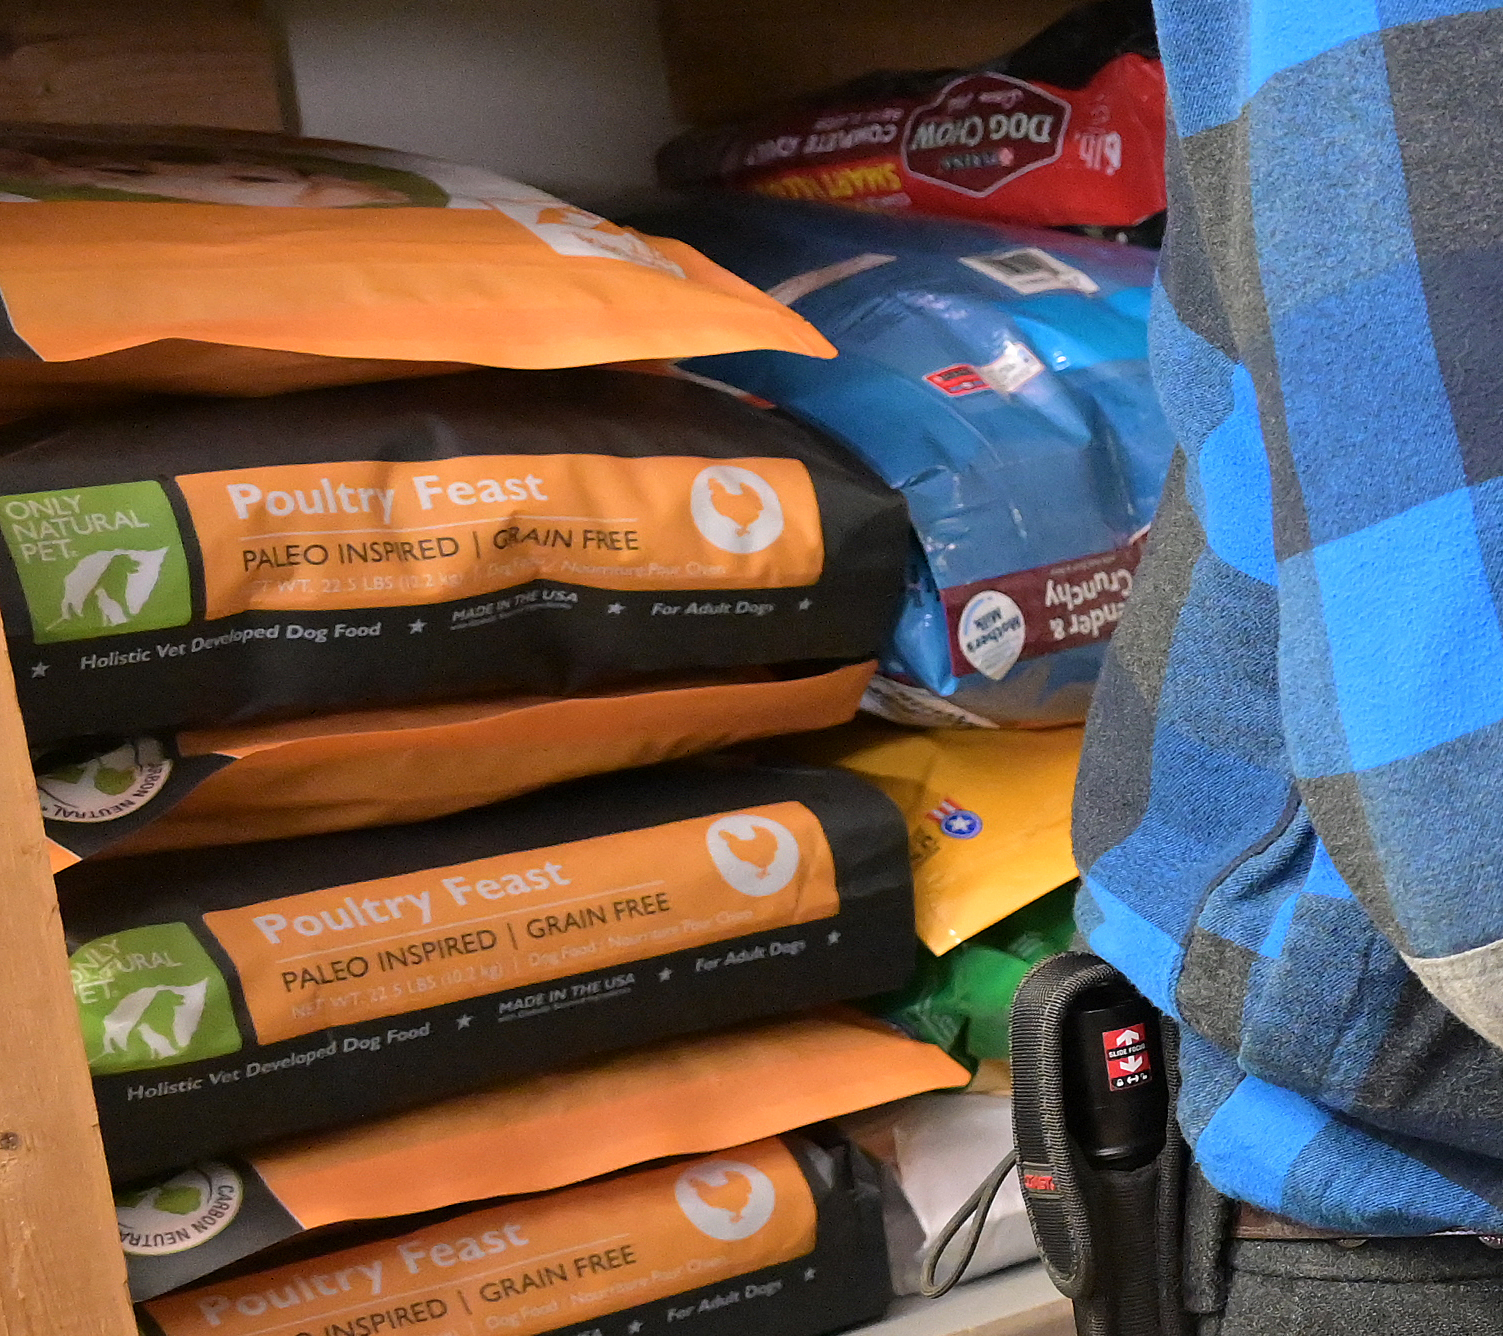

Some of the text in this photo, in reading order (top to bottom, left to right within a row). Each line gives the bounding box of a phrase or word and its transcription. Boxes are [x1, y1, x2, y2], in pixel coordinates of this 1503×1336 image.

[909, 115, 983, 151] CHOW
[988, 113, 1055, 144] DOG
[4, 494, 82, 519] ONLY
[225, 472, 549, 525] Poultry Feast
[11, 509, 151, 543] NATURAL
[242, 527, 640, 572] PALEO INSPIRED GRAIN FREE
[541, 589, 579, 605] USA
[650, 601, 681, 618] For
[1045, 568, 1134, 611] Crunchy
[79, 620, 383, 672] Holistic Vet Developed Dog Food
[252, 861, 573, 945] Poultry Feast
[281, 892, 672, 993] PALEO INSPIRED GRAIN FREE
[72, 978, 116, 1004] ET
[499, 972, 636, 1014] MADE IN THE USA
[126, 1022, 431, 1102] Holistic Vet Developed Dog Food
[190, 1184, 235, 1234] CARBON
[200, 1221, 530, 1326] Poultry Feast
[479, 1267, 569, 1304] GRAIN
[573, 1244, 637, 1280] FREE
